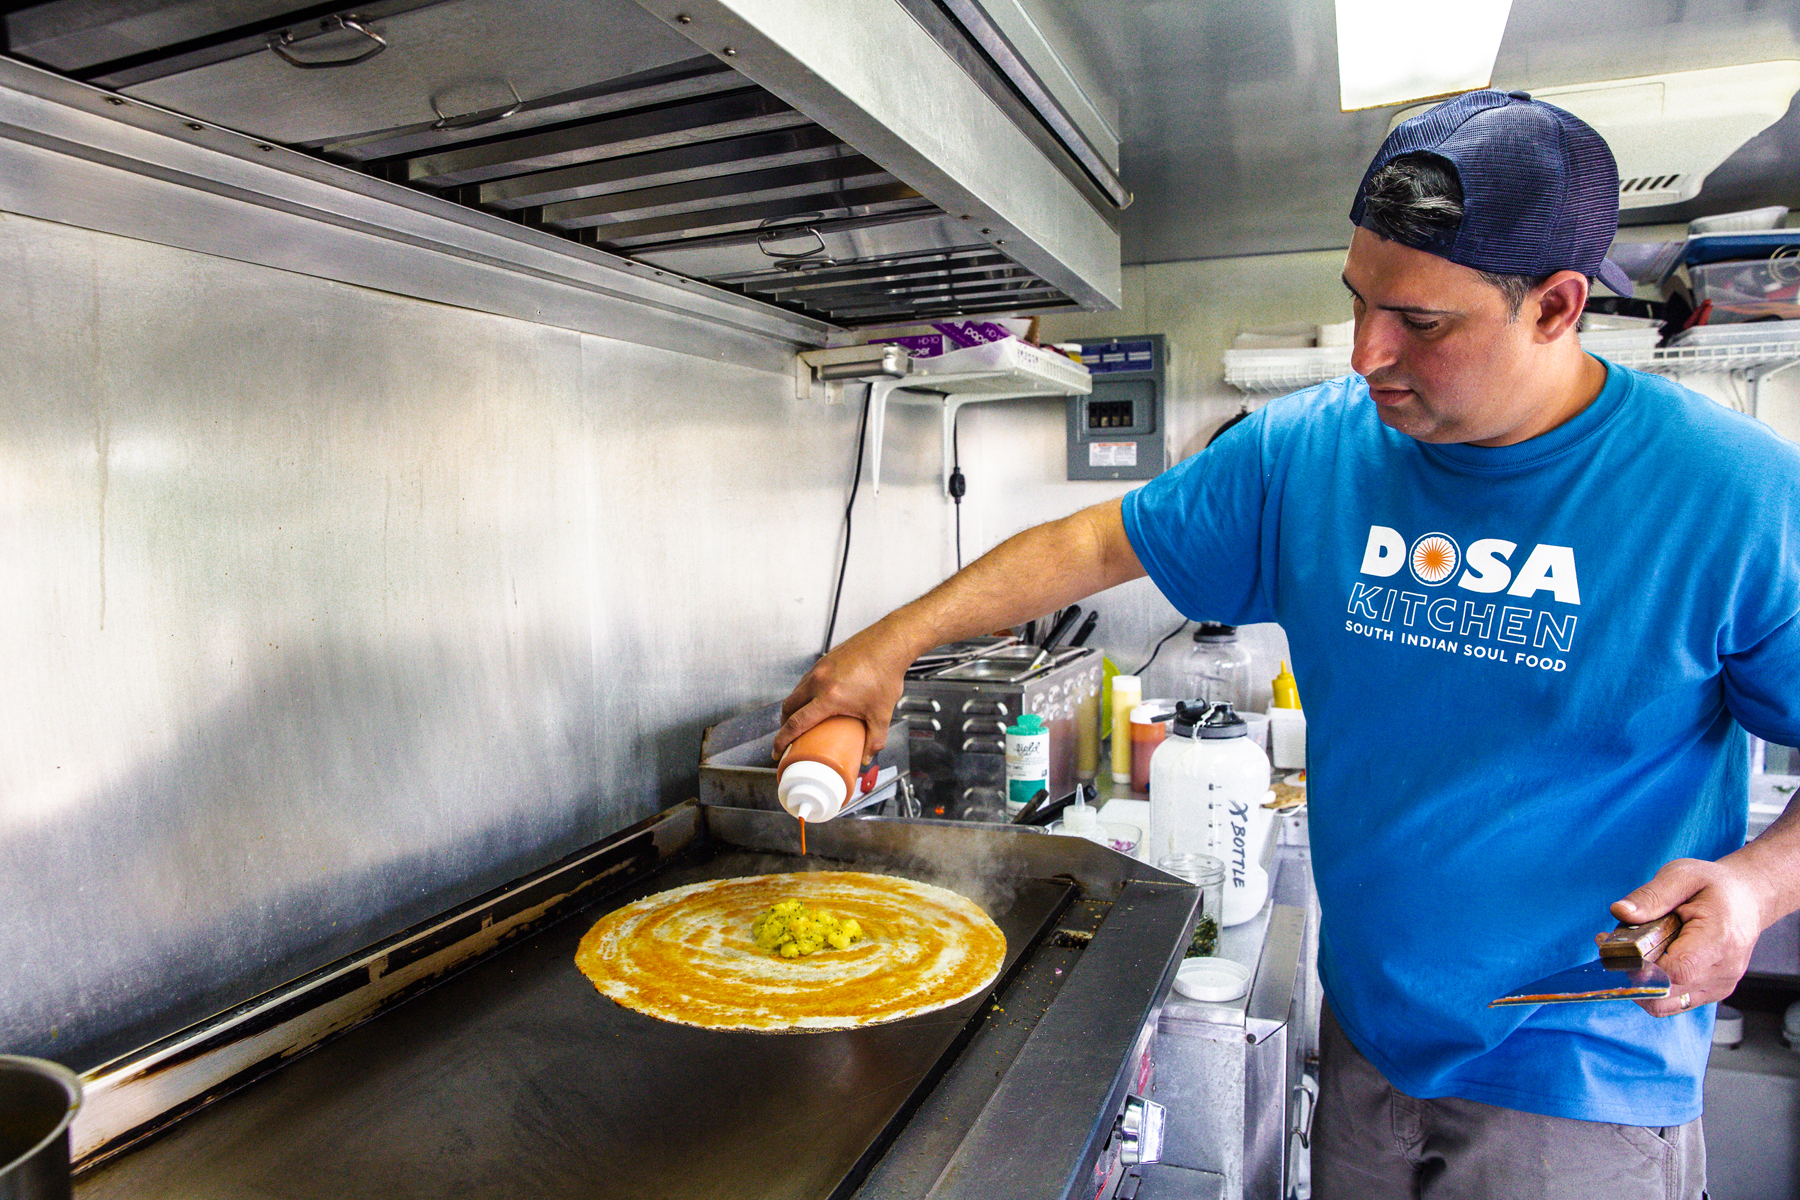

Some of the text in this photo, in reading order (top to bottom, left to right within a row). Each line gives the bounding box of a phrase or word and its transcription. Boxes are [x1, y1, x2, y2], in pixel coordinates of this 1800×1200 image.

[1360, 524, 1581, 605] DOSA
[1345, 620, 1567, 672] SOUTH INDIAN SOUL FOOD
[1347, 582, 1578, 652] KITCHEN
[1230, 821, 1247, 888] BOTTLE
